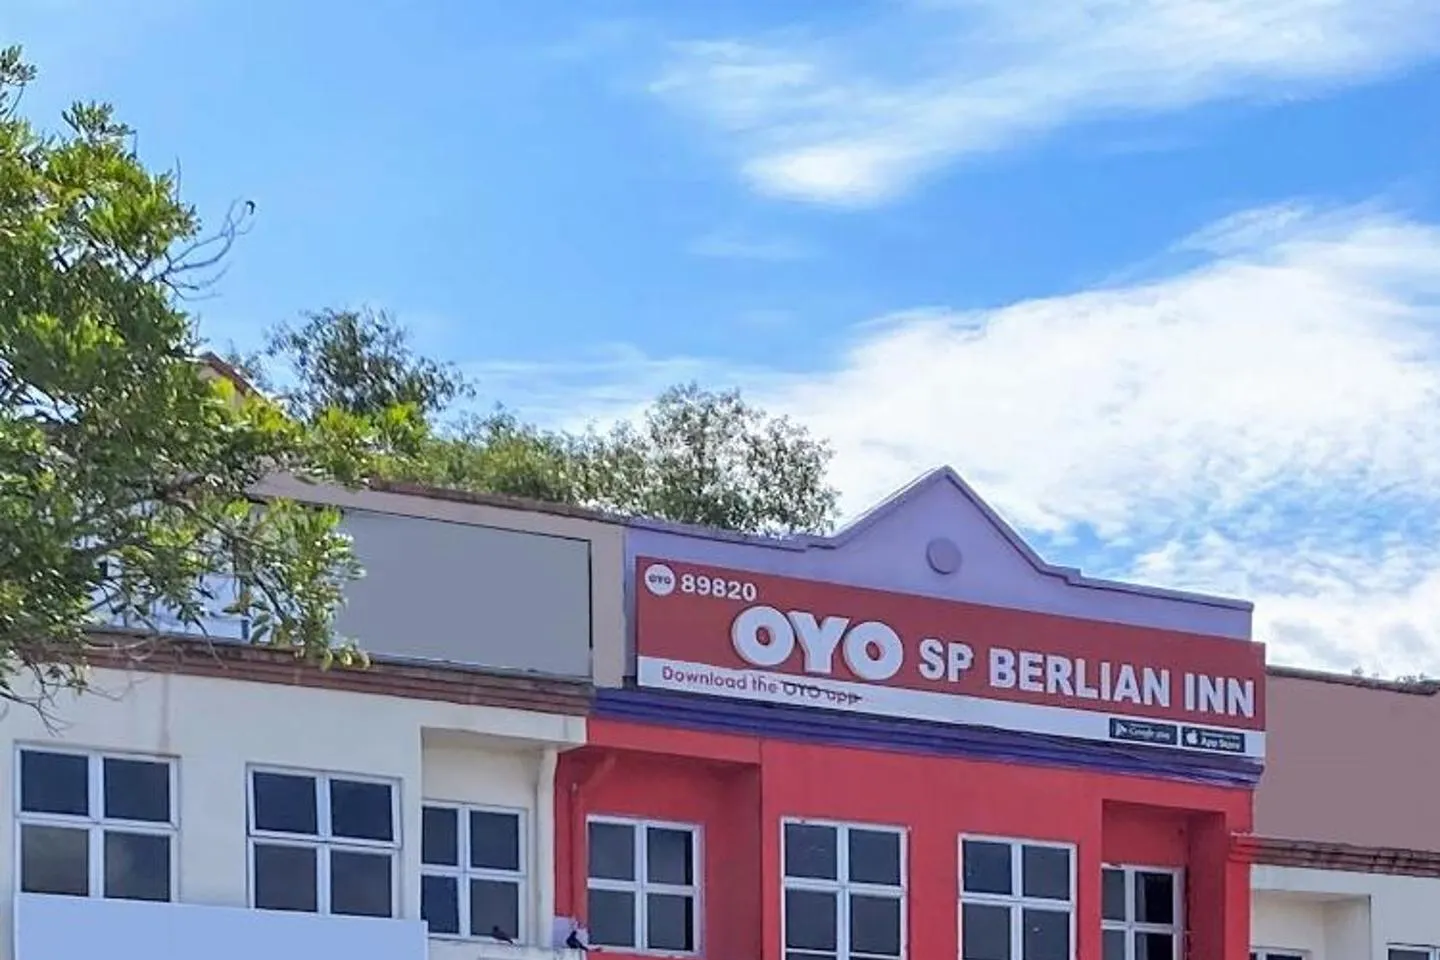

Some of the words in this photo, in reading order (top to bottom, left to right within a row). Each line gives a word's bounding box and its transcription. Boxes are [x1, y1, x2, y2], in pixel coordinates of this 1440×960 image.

[680, 573, 758, 602] 89820
[731, 604, 905, 682] OYO
[918, 638, 973, 683] SP
[989, 646, 1171, 709] BERLIAN
[1184, 672, 1256, 719] INN
[662, 665, 748, 692] Download
[752, 675, 778, 695] the
[782, 681, 821, 700] OYO
